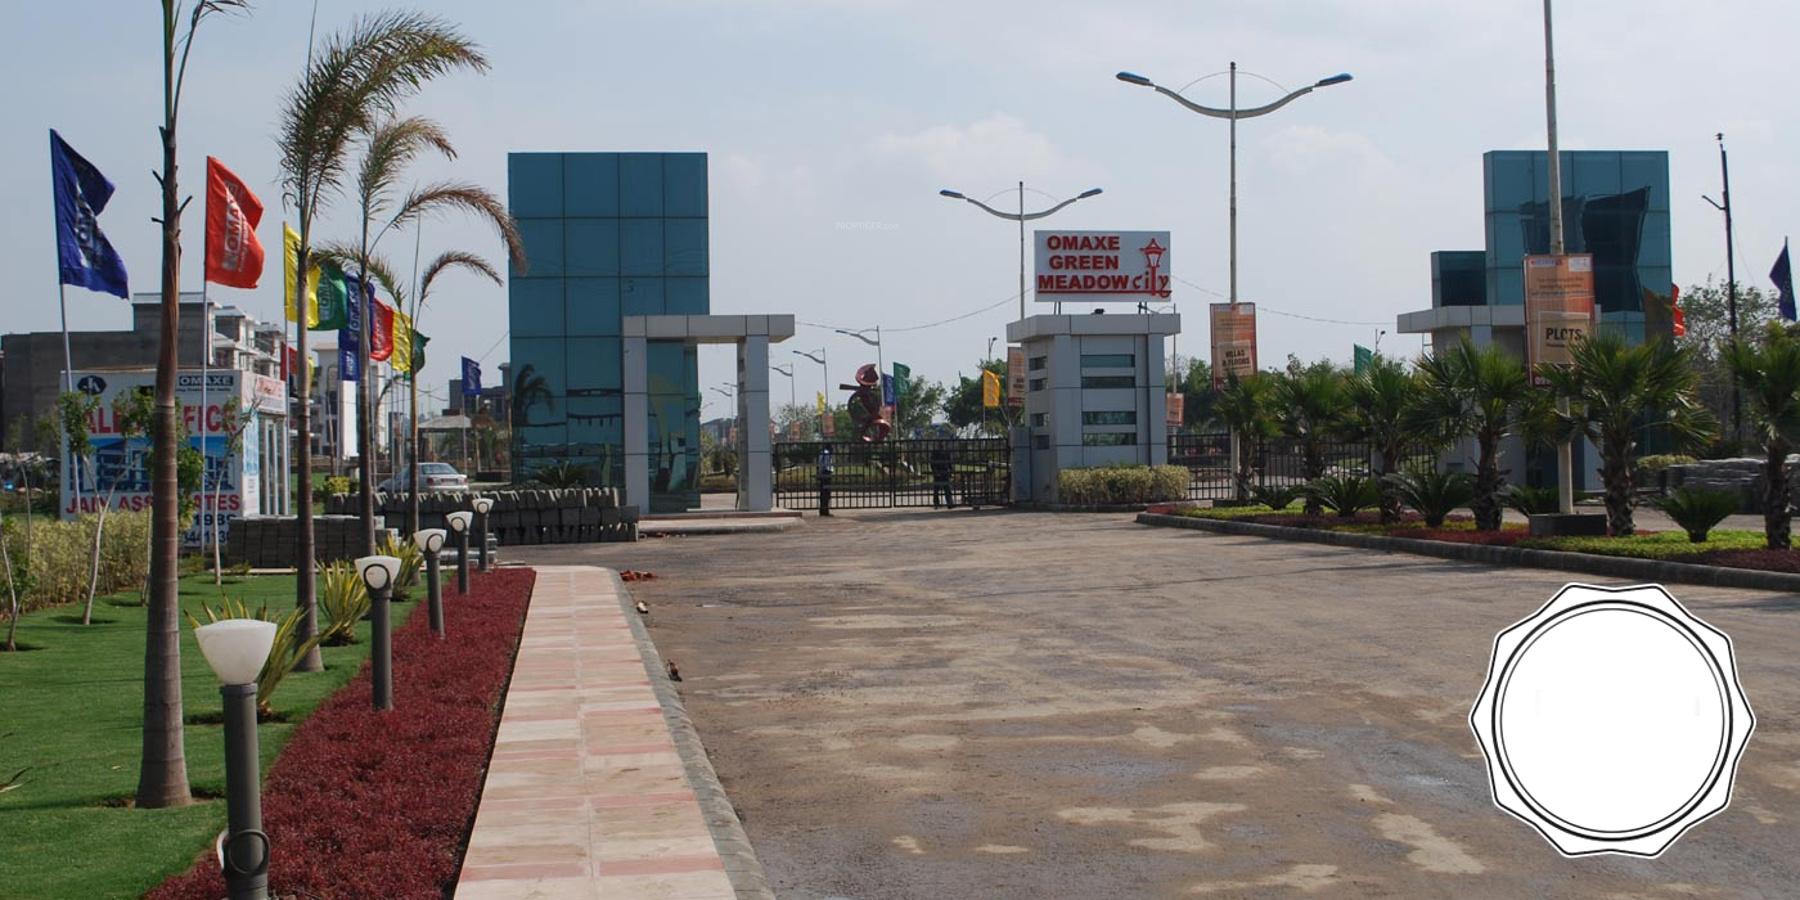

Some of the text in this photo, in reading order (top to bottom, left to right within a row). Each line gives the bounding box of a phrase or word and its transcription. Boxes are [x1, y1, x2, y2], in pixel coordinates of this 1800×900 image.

[1047, 236, 1120, 250] OMAXE
[1049, 255, 1119, 269] GREEN
[1038, 274, 1129, 289] MEADOW
